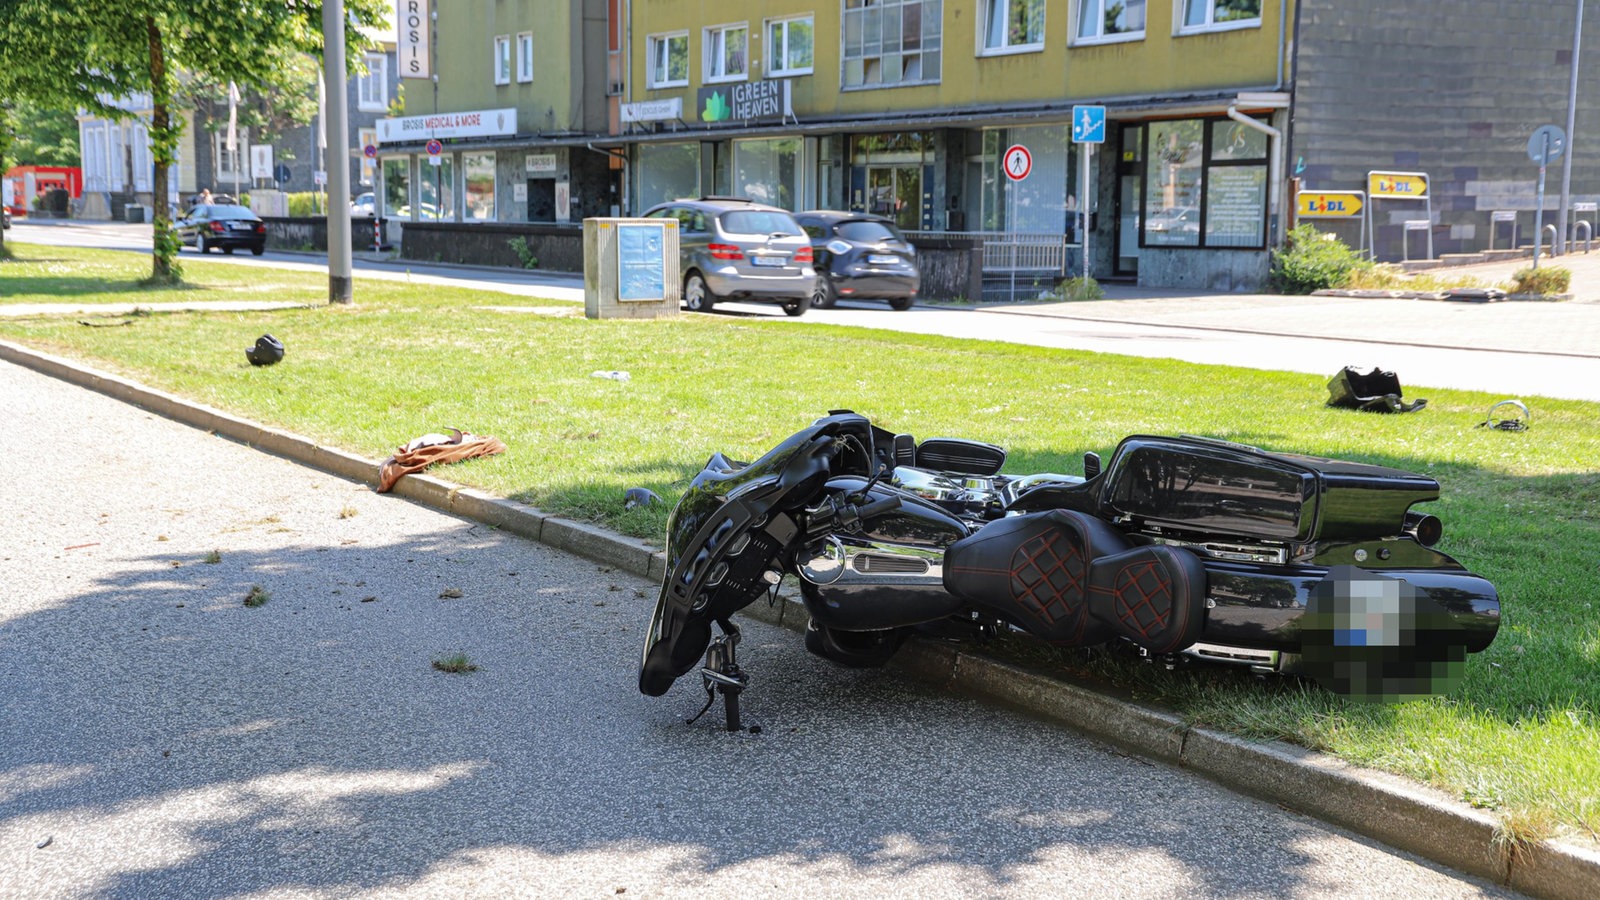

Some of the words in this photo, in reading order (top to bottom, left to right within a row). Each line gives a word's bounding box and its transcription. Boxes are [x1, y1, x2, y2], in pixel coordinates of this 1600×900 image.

[408, 0, 420, 73] ROSIS
[735, 80, 778, 103] GREEN
[737, 96, 779, 120] HEAVEN
[402, 119, 424, 131] BROSIS
[425, 117, 454, 129] MEDICAL
[455, 116, 460, 127] &
[461, 114, 481, 126] MORE
